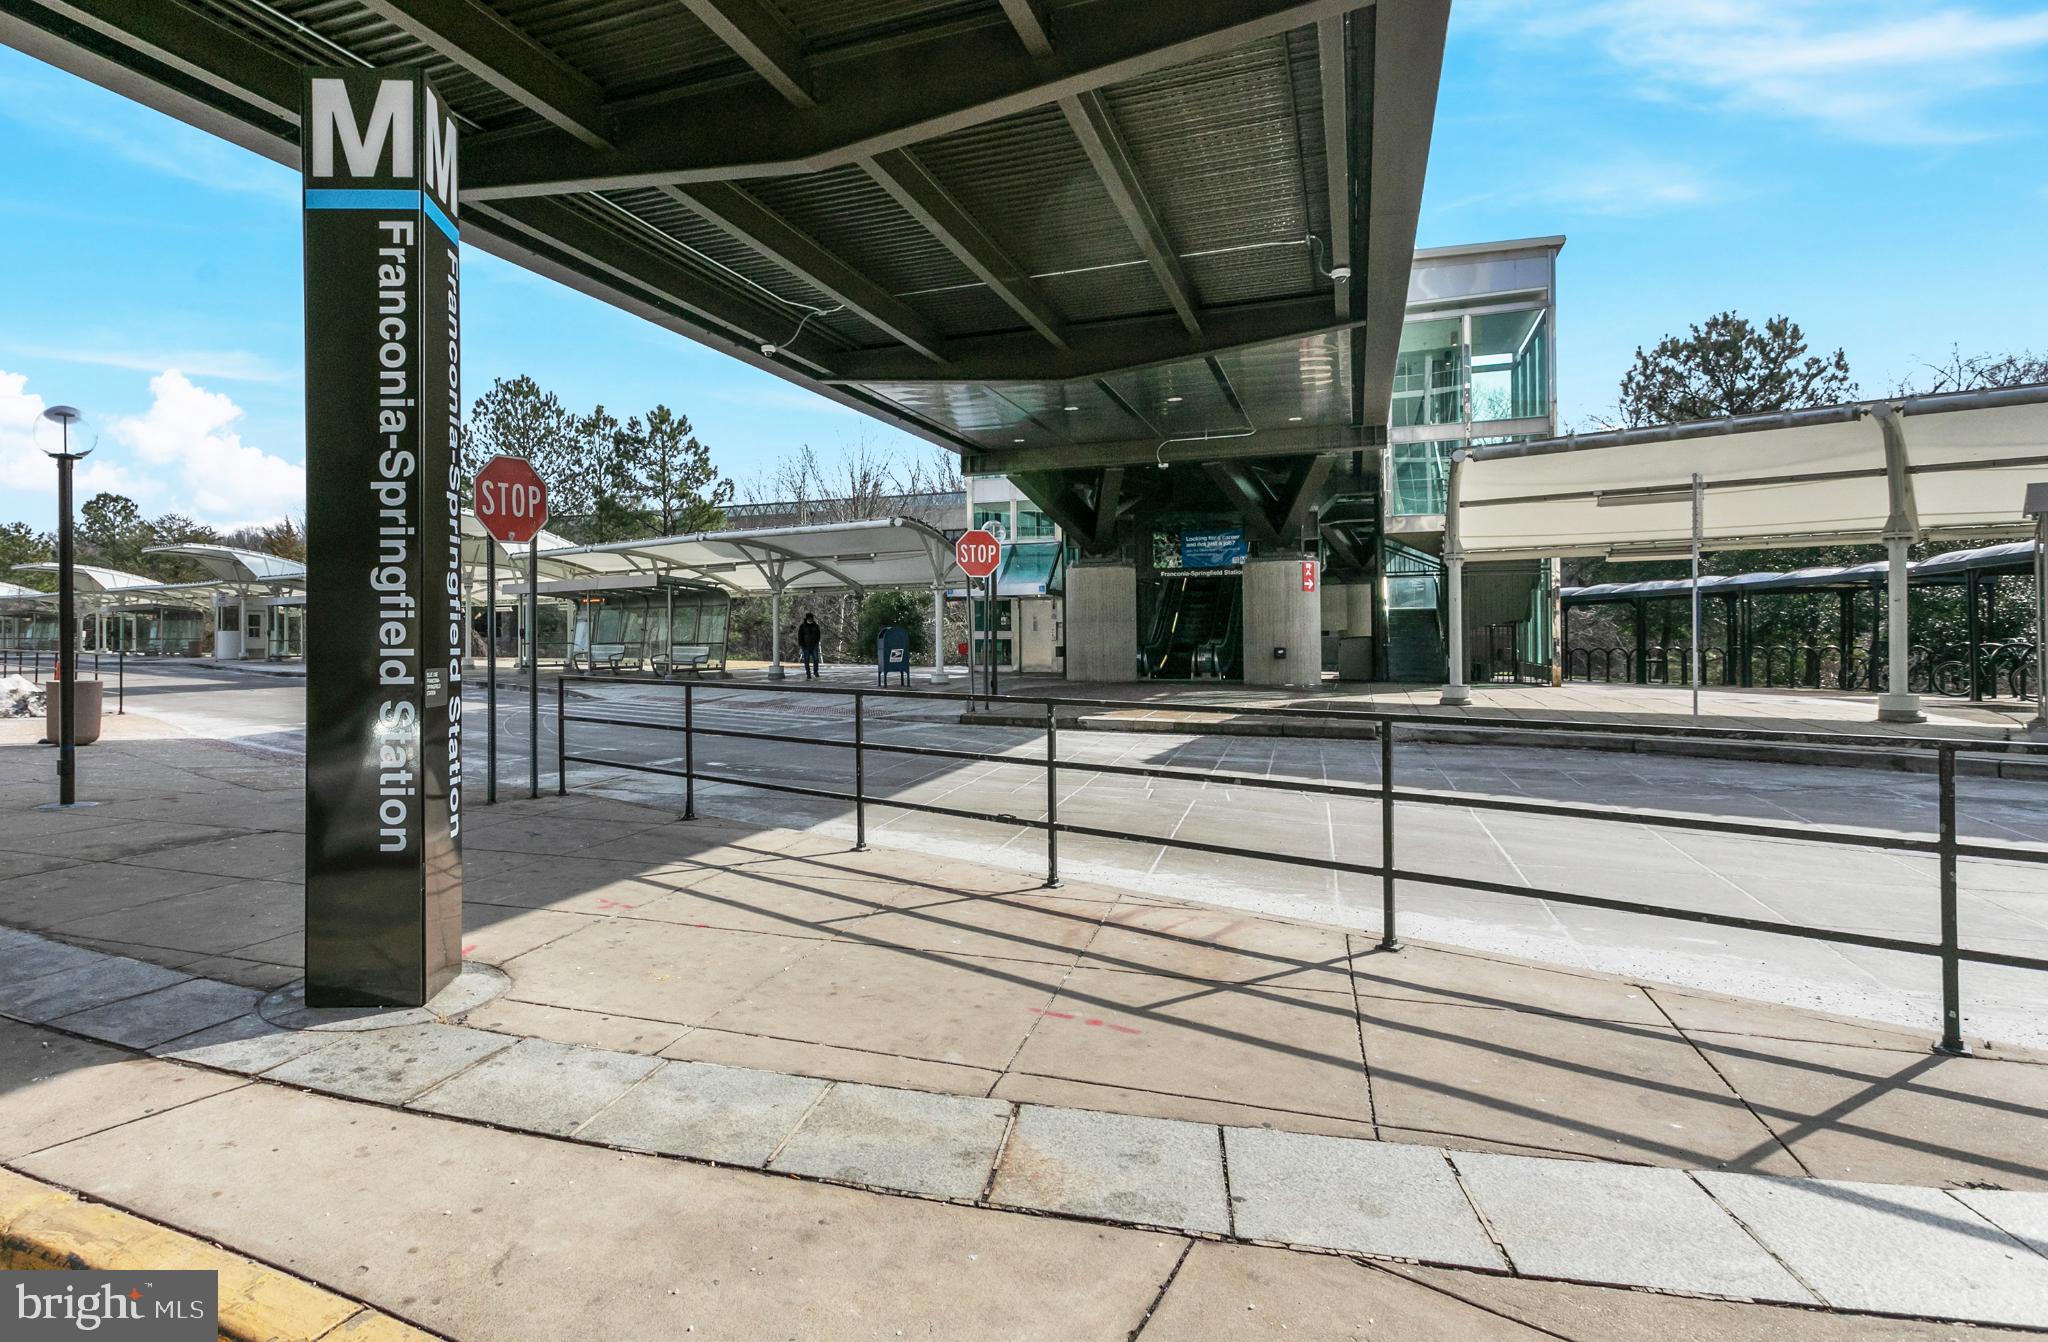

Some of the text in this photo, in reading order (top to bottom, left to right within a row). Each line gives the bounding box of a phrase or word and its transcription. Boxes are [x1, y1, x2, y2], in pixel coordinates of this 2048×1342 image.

[311, 77, 414, 178] M
[425, 86, 458, 218] M
[370, 220, 416, 852] Franconia-Springfield Station
[446, 248, 462, 838] Franconia-Springfield Station
[481, 480, 541, 518] STOP
[960, 544, 997, 563] STOP
